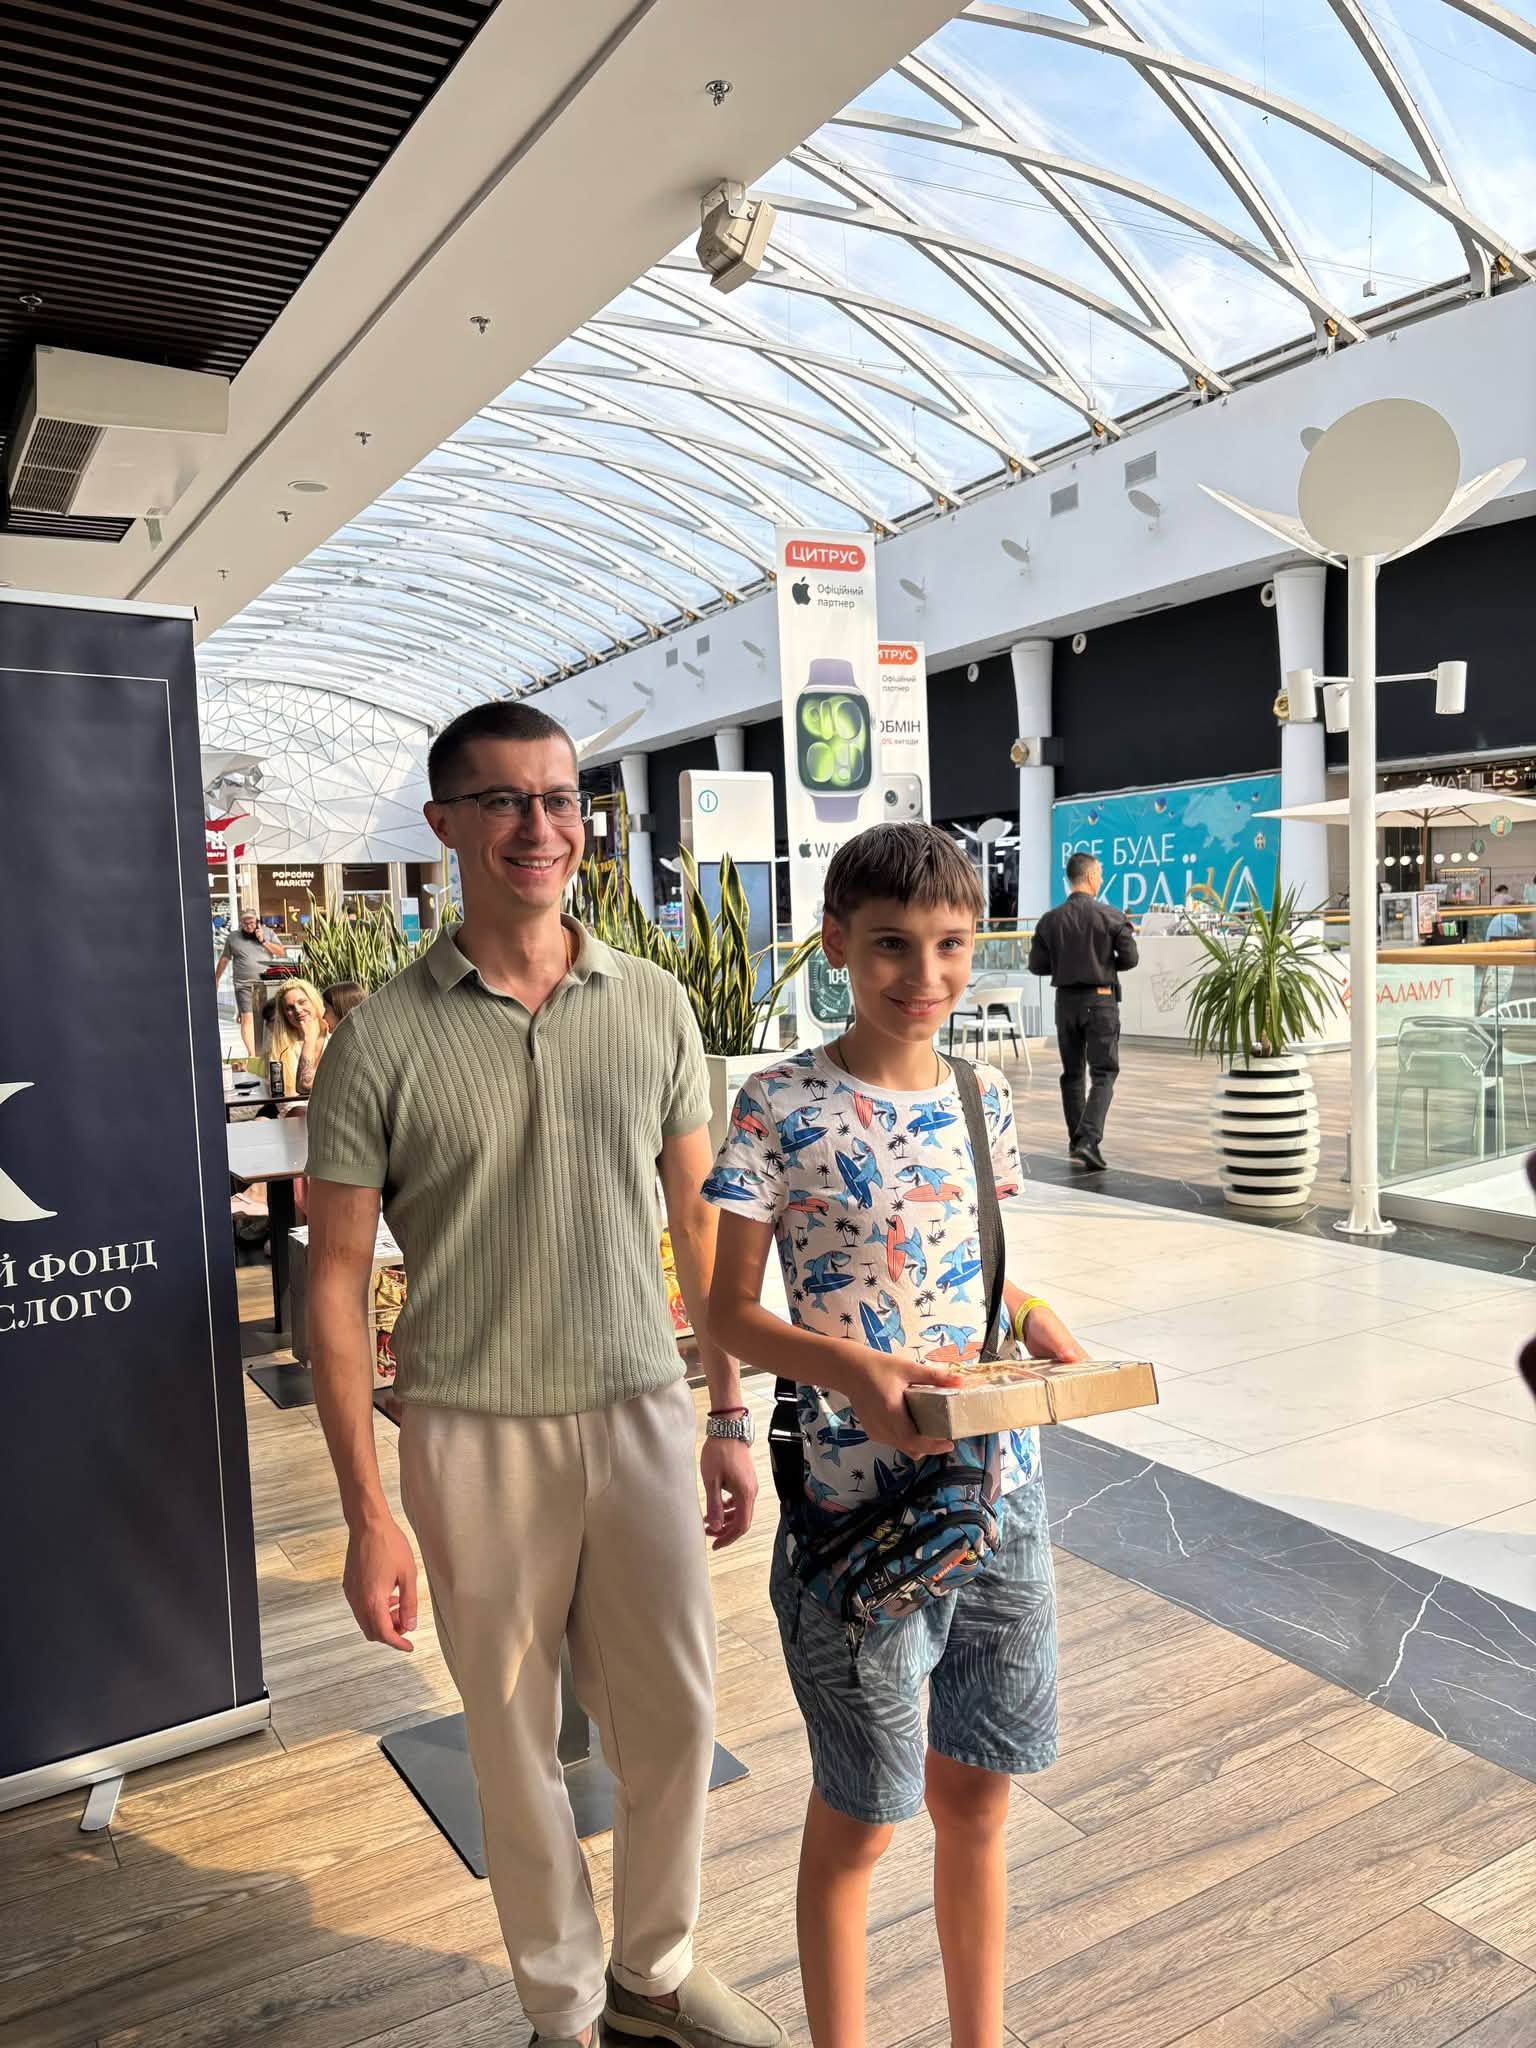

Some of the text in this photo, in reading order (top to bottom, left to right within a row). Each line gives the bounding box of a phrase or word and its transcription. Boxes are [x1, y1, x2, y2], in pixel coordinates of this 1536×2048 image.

[791, 547, 859, 565] ЦИТРУС
[817, 583, 864, 596] Офіційний
[817, 598, 855, 609] партнер
[1113, 833, 1176, 868] БУДЕ
[272, 871, 314, 879] POPCORN
[275, 879, 312, 887] MARKET
[28, 1239, 158, 1283] ФОНД
